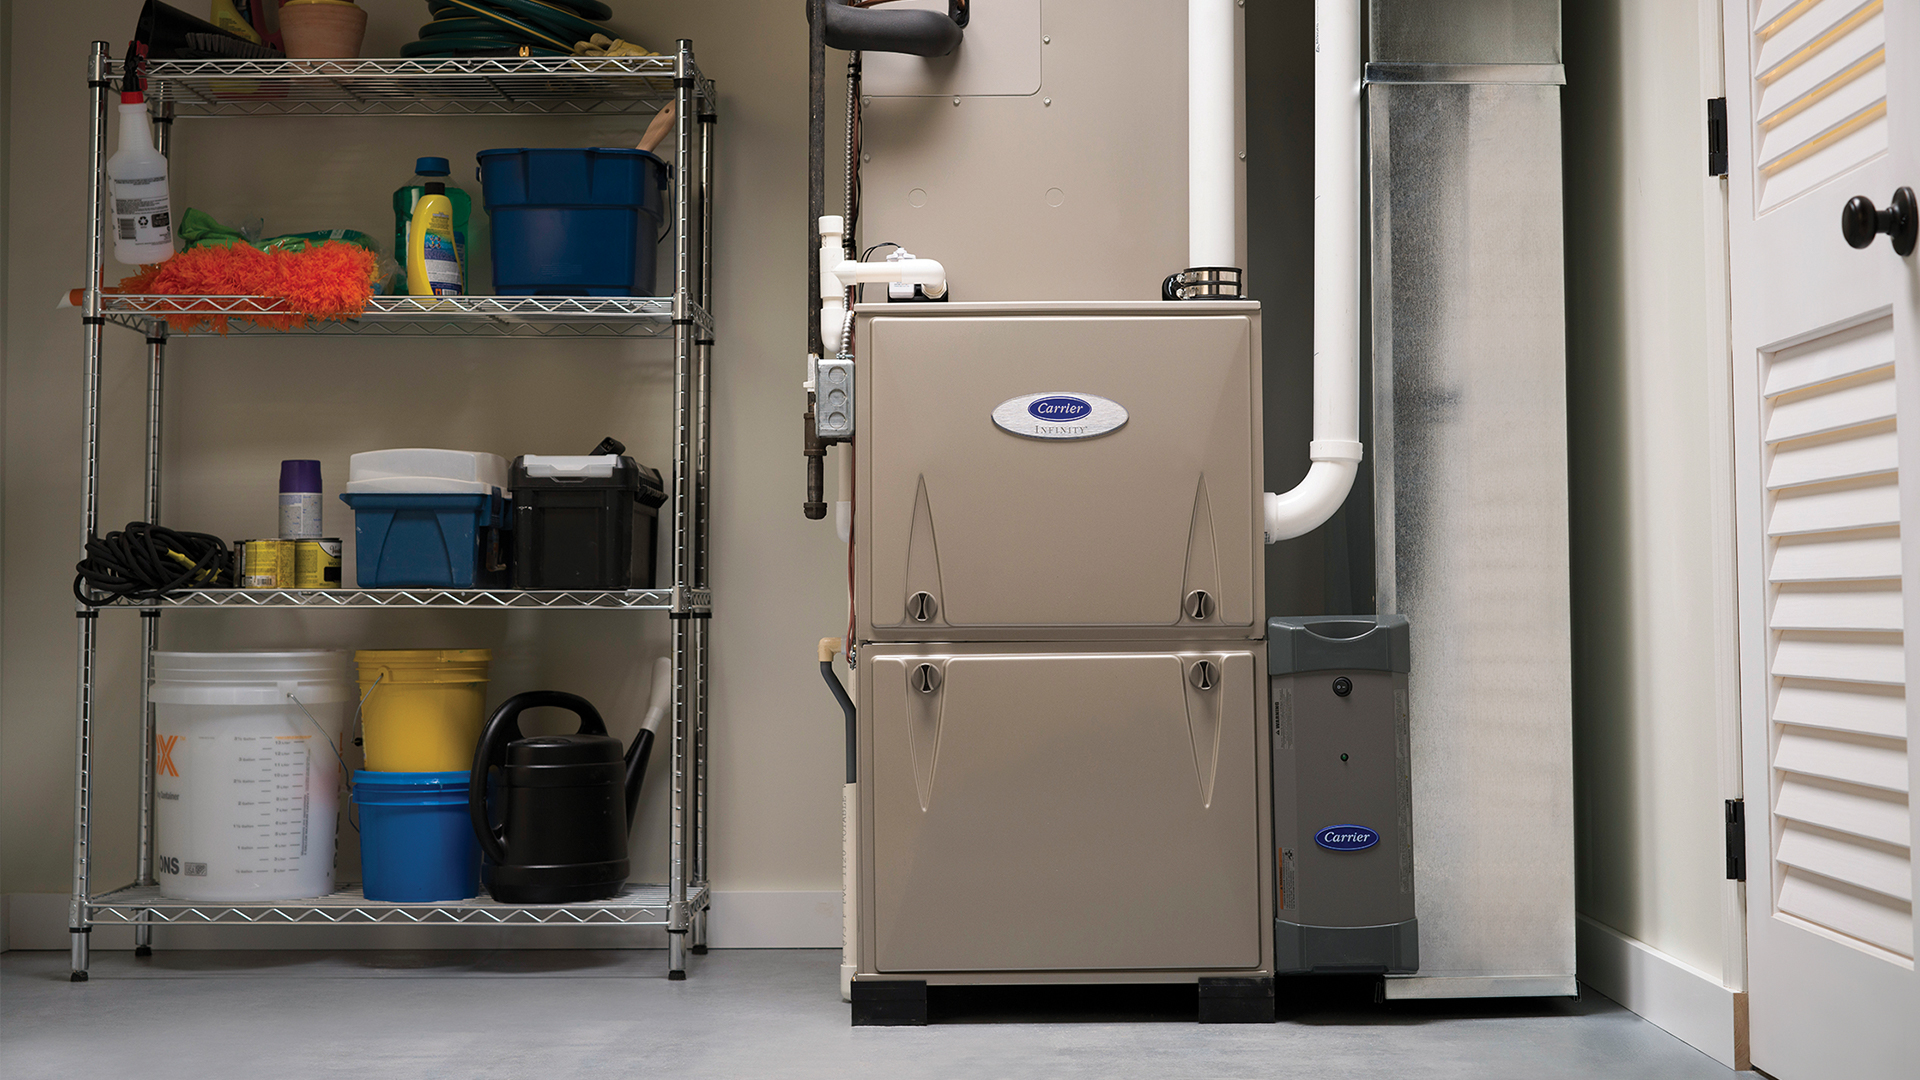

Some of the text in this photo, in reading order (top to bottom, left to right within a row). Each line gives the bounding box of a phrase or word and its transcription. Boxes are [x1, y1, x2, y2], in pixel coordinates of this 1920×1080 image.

[1037, 402, 1084, 414] Carrier
[1035, 425, 1084, 434] INFINITY
[1324, 831, 1370, 843] Carrier
